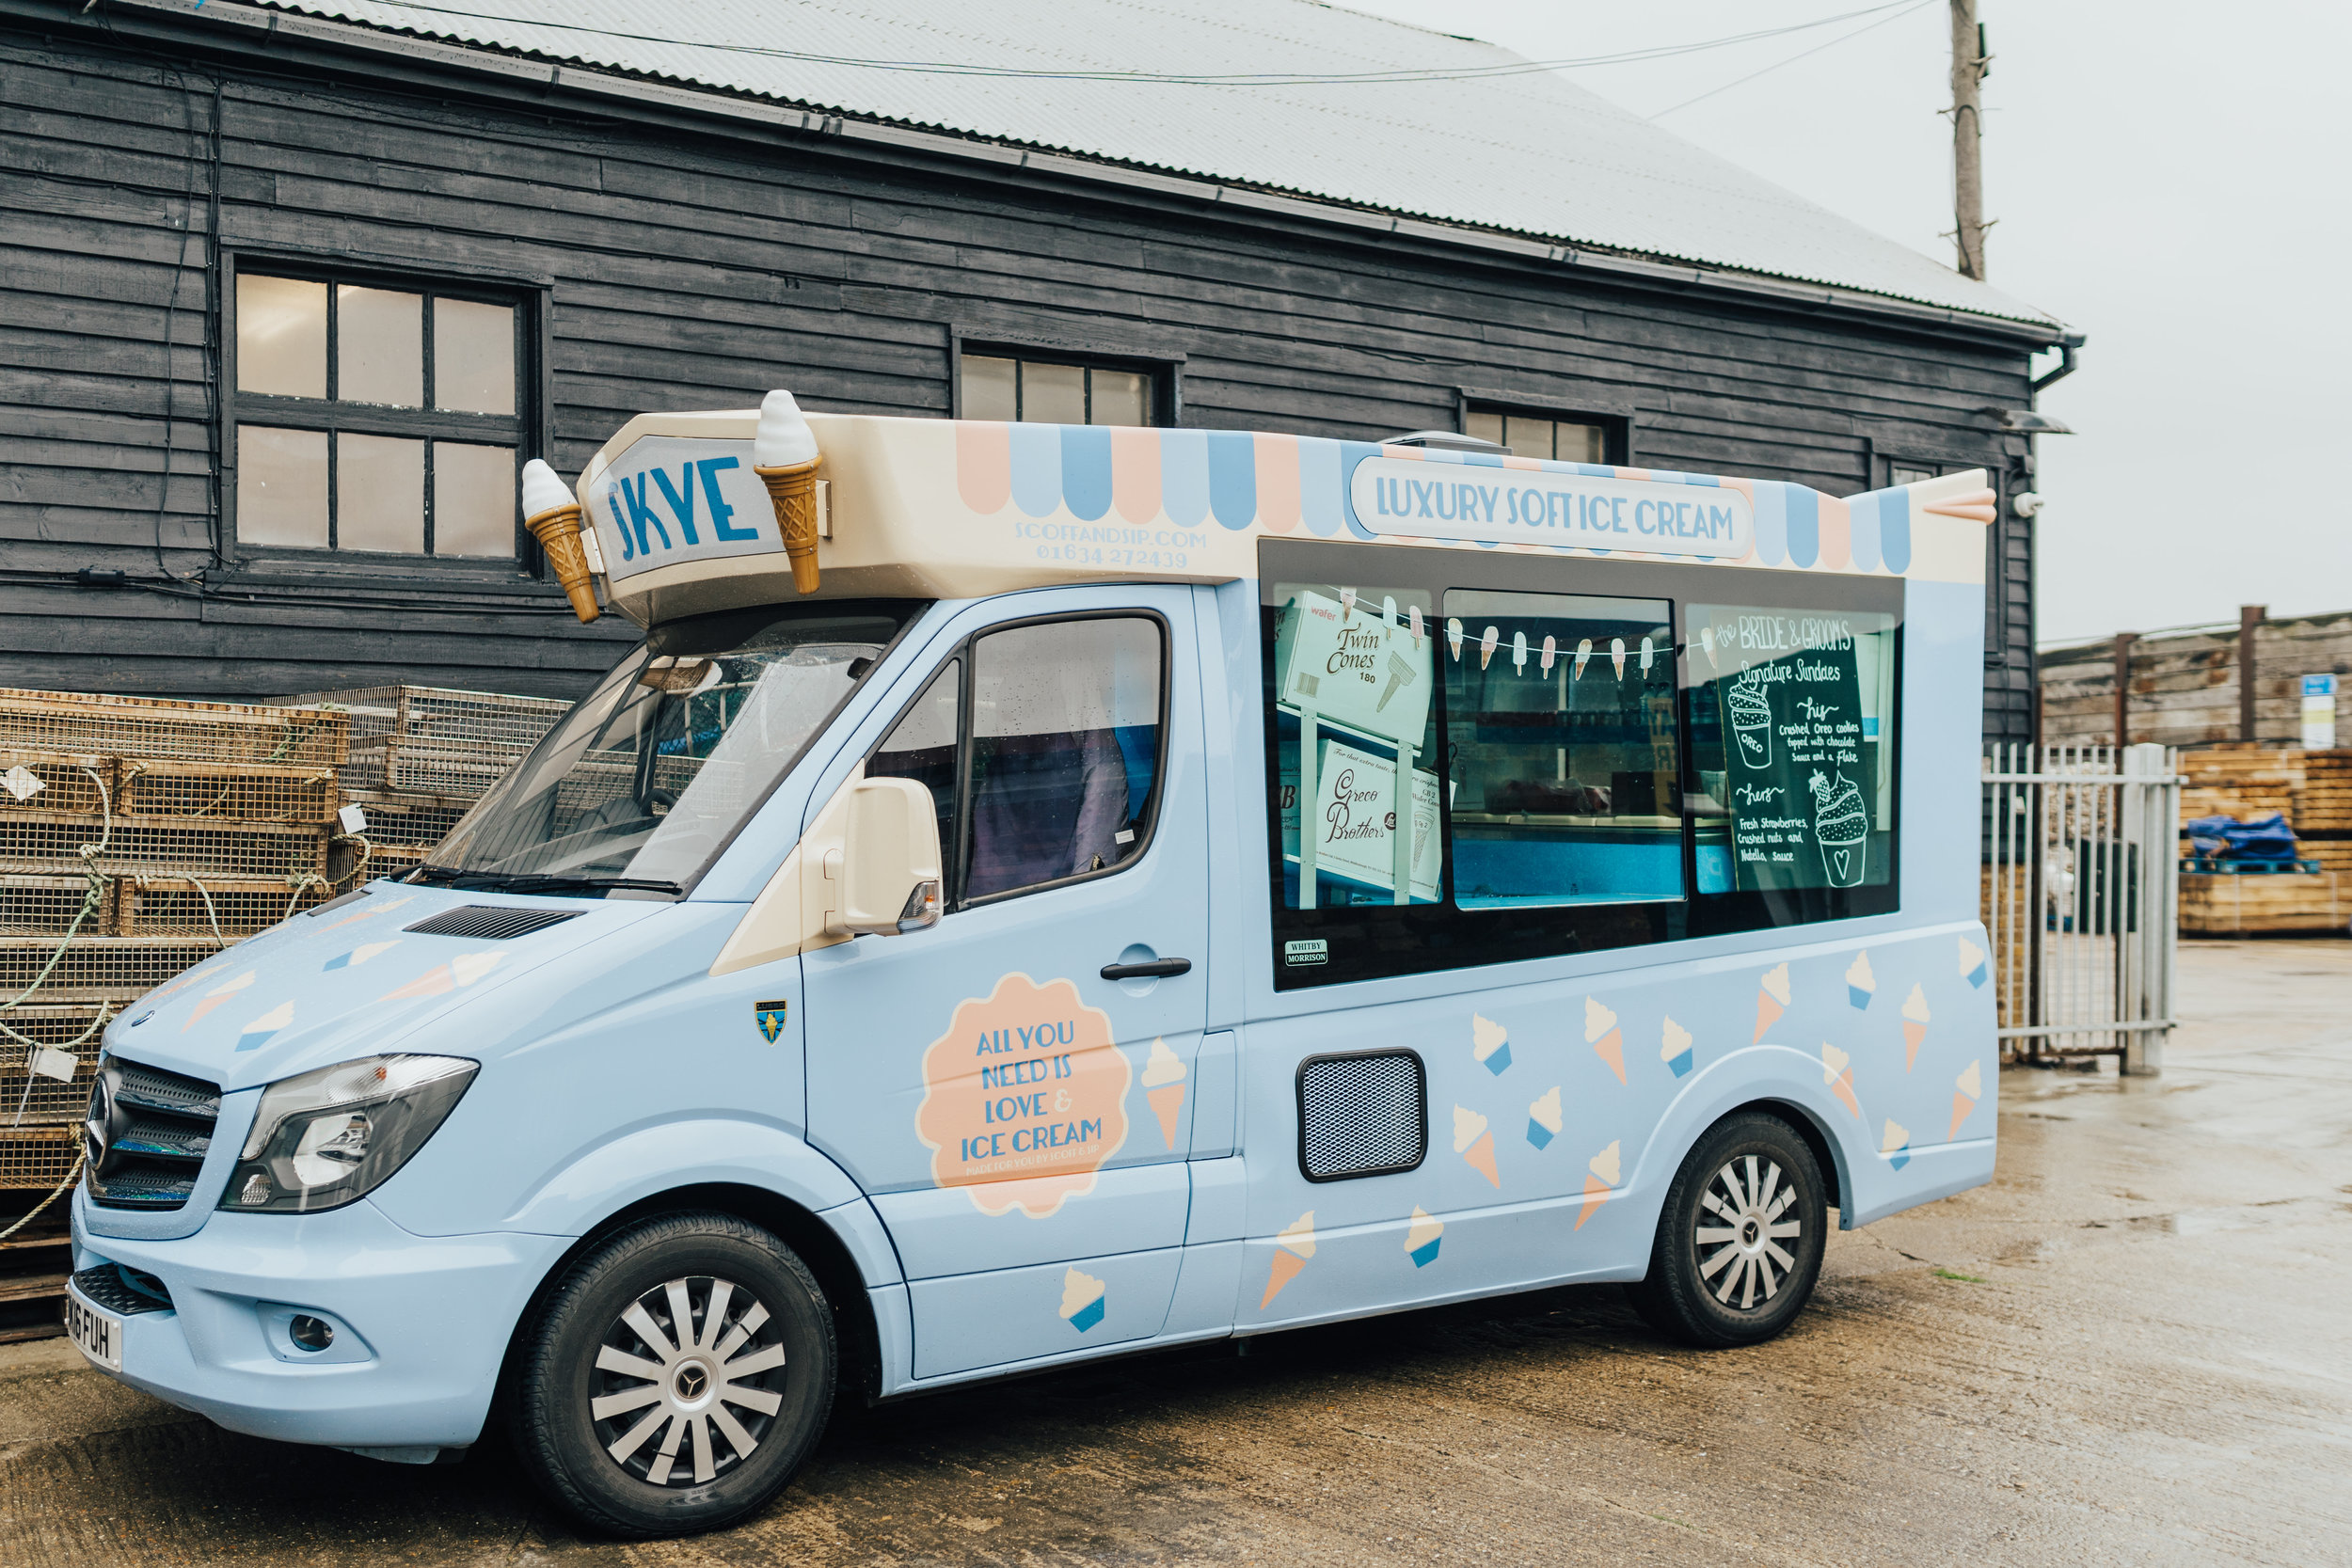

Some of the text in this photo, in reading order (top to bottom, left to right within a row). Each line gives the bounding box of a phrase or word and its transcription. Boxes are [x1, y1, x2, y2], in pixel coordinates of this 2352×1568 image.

[609, 456, 759, 562] SKYE
[1376, 477, 1734, 541] LUXURY SOFT ICE CREAM
[1015, 522, 1207, 548] SCOFFANDSIP.COM
[1037, 544, 1187, 569] 01634 272439
[1311, 605, 1336, 622] wafer
[1337, 622, 1379, 651] Twin
[1716, 624, 1737, 648] the
[1739, 615, 1788, 650] BRIDE
[1789, 620, 1801, 647] &
[1327, 651, 1375, 674] Cones
[1739, 658, 1841, 691] Signature Sundaes
[1359, 672, 1376, 685] 180
[1796, 696, 1840, 721] his
[1779, 721, 1810, 736] Crushed
[1814, 723, 1833, 734] Oreo
[1741, 734, 1763, 753] OREO
[1787, 735, 1855, 751] topped with chocolate
[1333, 748, 1346, 757] For
[1347, 752, 1359, 761] that
[1359, 758, 1374, 767] extra
[1812, 749, 1825, 761] and
[1836, 749, 1858, 767] Flake
[1334, 768, 1381, 810] Greco
[1736, 783, 1785, 806] hers
[1325, 801, 1385, 844] Brothers
[1740, 817, 1759, 830] Fresh
[1738, 831, 1804, 845] Crushed nuts and
[1740, 847, 1767, 863] Nutella
[1287, 953, 1326, 963] MORRISON
[1291, 942, 1321, 950] WHITBY
[976, 1021, 1074, 1056] ALL YOU
[982, 1053, 1073, 1089] NEED IS
[985, 1088, 1073, 1124] LOVE &
[961, 1117, 1102, 1162] ICE CREAM
[966, 1165, 994, 1176] MADE
[995, 1161, 1013, 1172] FOR
[1014, 1156, 1035, 1168] YOU
[1036, 1153, 1049, 1164] BY
[1087, 1144, 1100, 1155] SIP
[83, 1308, 109, 1359] FUH
